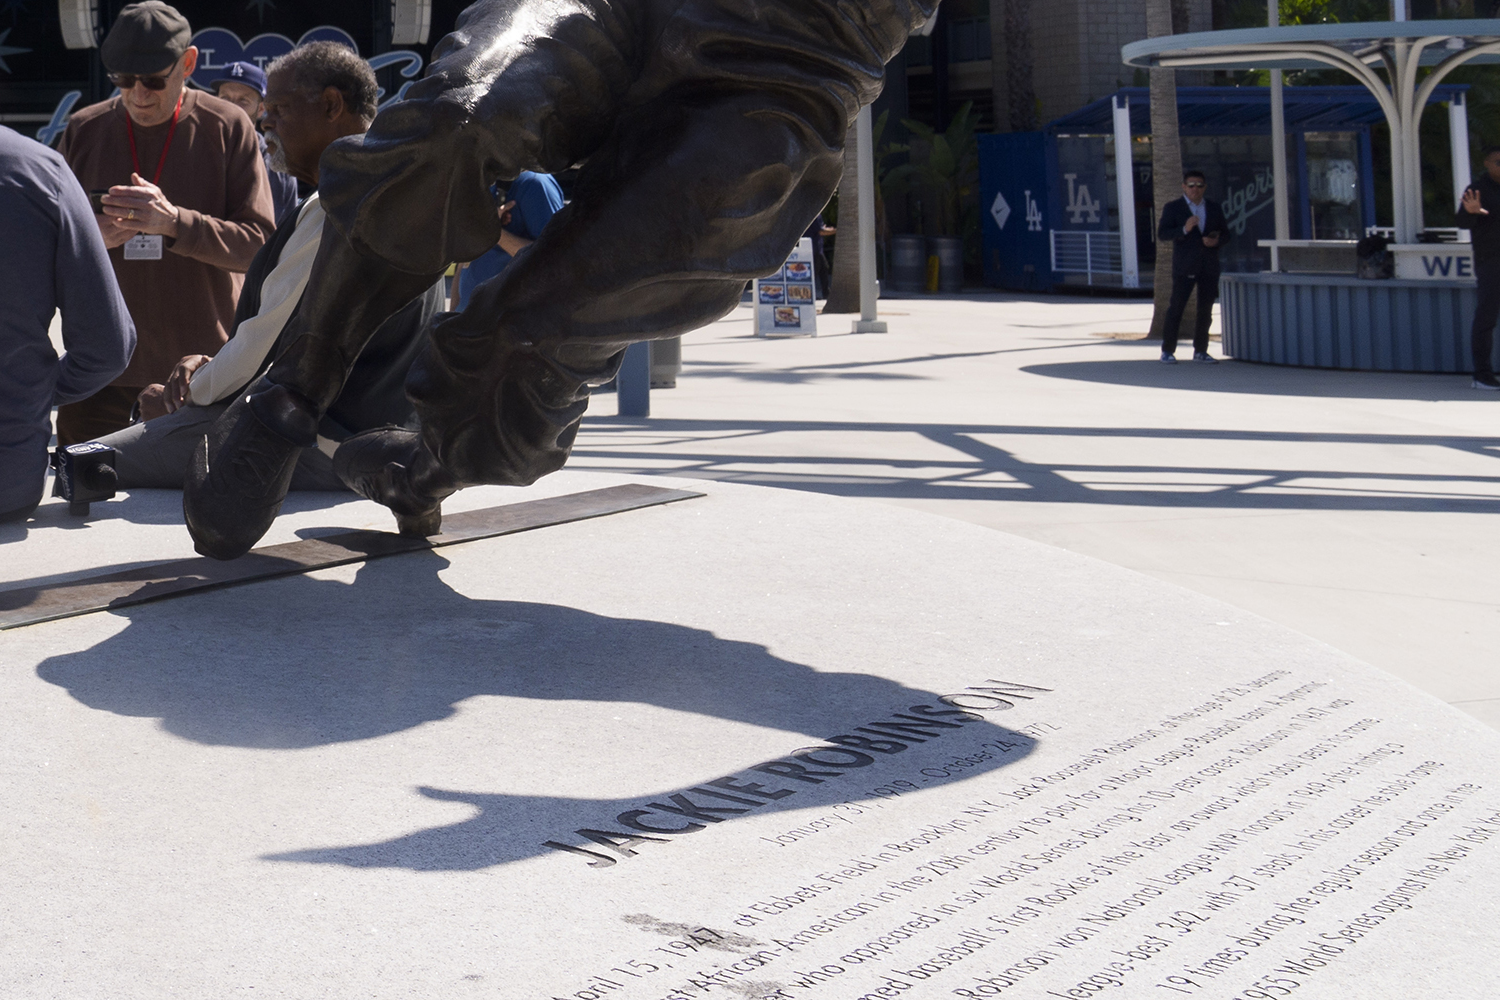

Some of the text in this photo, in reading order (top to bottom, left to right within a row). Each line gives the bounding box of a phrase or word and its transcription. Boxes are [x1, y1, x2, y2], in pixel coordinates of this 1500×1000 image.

[1024, 190, 1042, 231] LA
[1064, 173, 1100, 223] LA
[541, 679, 1054, 868] JACKIE ROBINSON
[759, 812, 853, 847] January
[865, 779, 920, 801] 1919
[920, 748, 993, 778] October
[1136, 776, 1208, 802] 10-year
[1020, 839, 1089, 864] Series
[1070, 814, 1144, 840] during
[609, 959, 676, 978] 15,
[652, 927, 745, 958] 1947,
[746, 884, 833, 915] Ebbets
[813, 859, 880, 884] Field
[881, 819, 983, 853] Brooklyn,
[960, 800, 1020, 818] N.Y.,
[998, 783, 1048, 800] Jack
[1029, 754, 1110, 785] Roosevelt
[1091, 730, 1173, 755] Robinson,
[682, 902, 880, 992] African-American
[885, 876, 934, 892] the
[914, 855, 976, 876] 20th
[965, 825, 1040, 855] century
[1040, 800, 1090, 820] play
[1102, 765, 1157, 785] Major
[1138, 744, 1203, 766] League
[968, 861, 1041, 889] World
[890, 927, 1012, 980] baseball's
[986, 905, 1046, 927] first
[1022, 876, 1101, 908] Rookie
[1099, 851, 1146, 866] the
[1123, 832, 1187, 853] Year,
[950, 889, 993, 904] six
[837, 912, 944, 964] appeared
[950, 947, 1063, 1000] Robinson
[1047, 926, 1102, 949] won
[1075, 882, 1170, 927] National
[775, 965, 848, 989] who
[1044, 934, 1176, 1000] league-best
[1231, 975, 1303, 1000] 955
